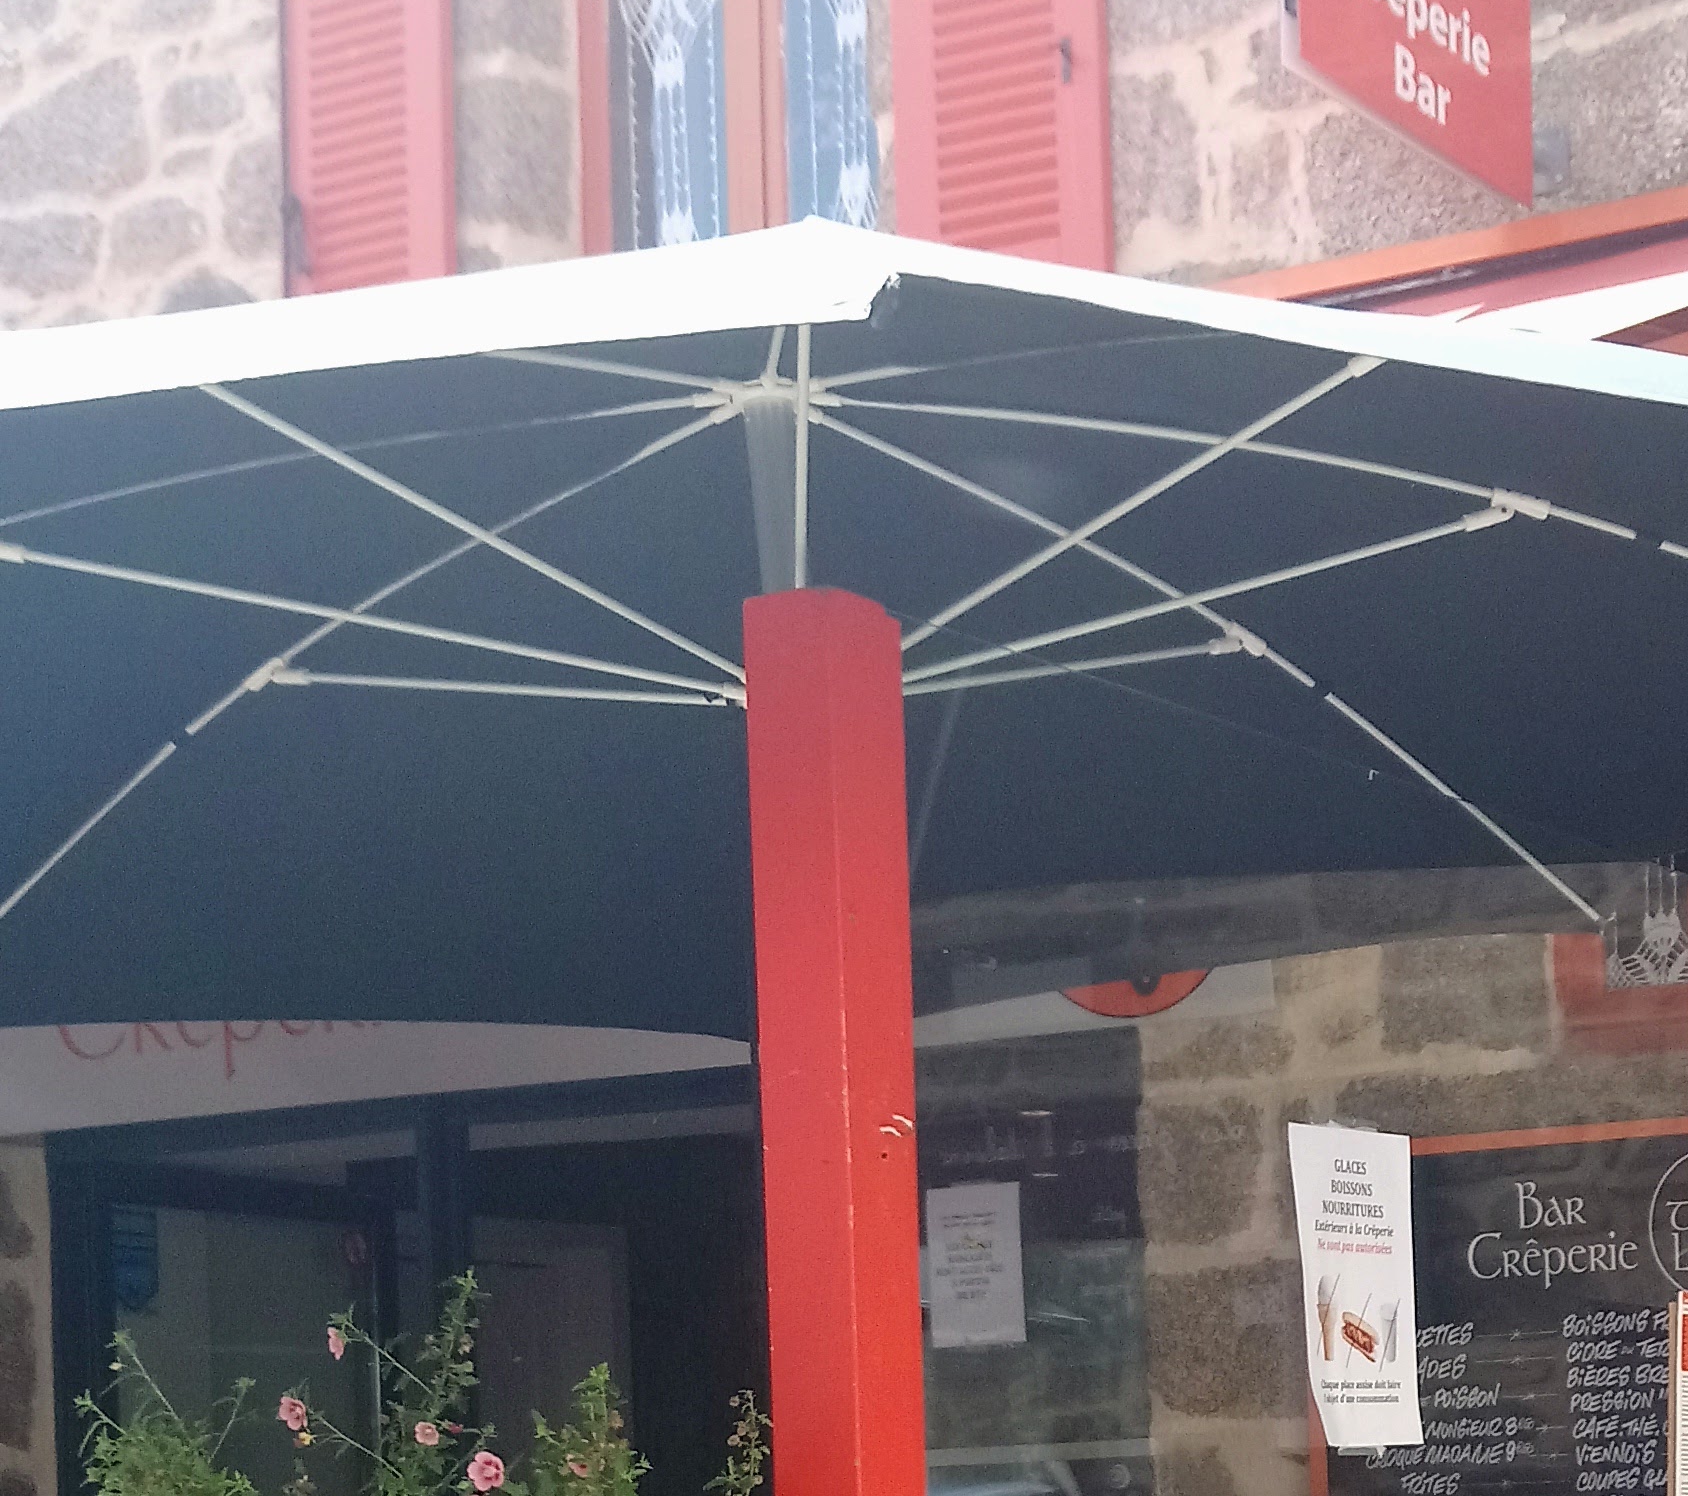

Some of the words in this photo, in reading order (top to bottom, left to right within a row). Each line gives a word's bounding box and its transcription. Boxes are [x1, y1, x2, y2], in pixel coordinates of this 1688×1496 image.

[1394, 41, 1451, 126] Bar
[1334, 1158, 1367, 1176] GLACES
[1330, 1179, 1373, 1197] BOISSONS
[1321, 1199, 1384, 1219] NOURRITURES
[1355, 1222, 1362, 1235] la
[1363, 1223, 1394, 1240] Crêperie
[1562, 1308, 1651, 1338] BOISSONS
[1566, 1339, 1622, 1363] CIDRE
[1566, 1364, 1632, 1389] BIÈRES
[1434, 1382, 1501, 1410] POISSON
[1570, 1387, 1655, 1414] PRESSION
[1424, 1416, 1505, 1440] MONSIEUR
[1425, 1442, 1505, 1465] MADAME
[1575, 1439, 1658, 1467] VIENNOIS
[1400, 1471, 1462, 1496] FRITES
[1576, 1466, 1641, 1492] COUPES
